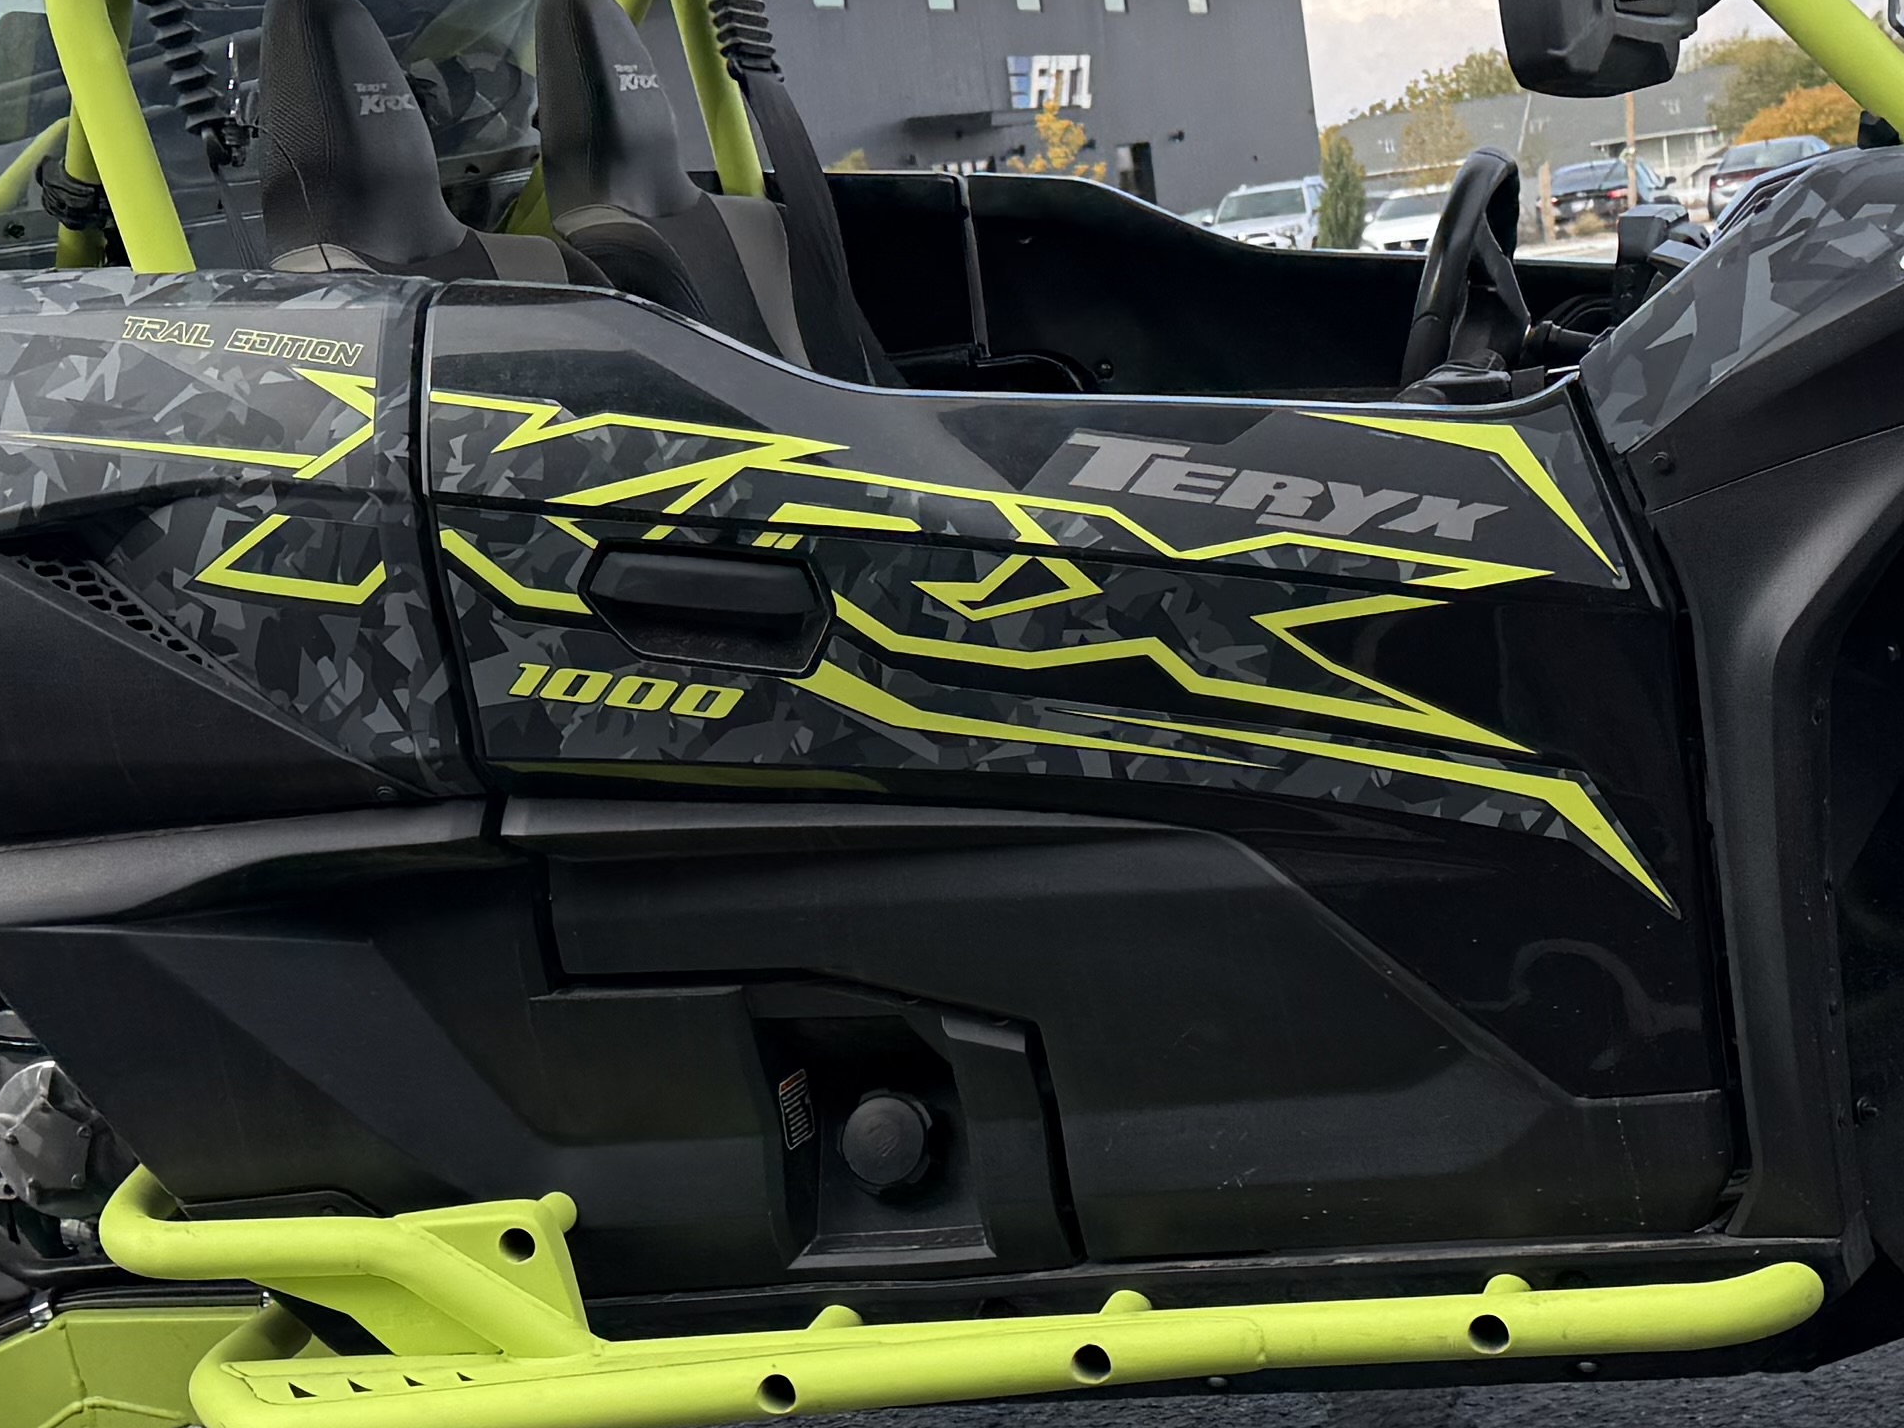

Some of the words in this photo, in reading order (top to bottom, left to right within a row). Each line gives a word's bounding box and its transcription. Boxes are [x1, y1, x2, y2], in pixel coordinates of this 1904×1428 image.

[122, 315, 214, 348] TRAIL
[224, 328, 364, 367] EDITION
[1066, 432, 1509, 542] TERYX
[508, 662, 745, 719] 1000
